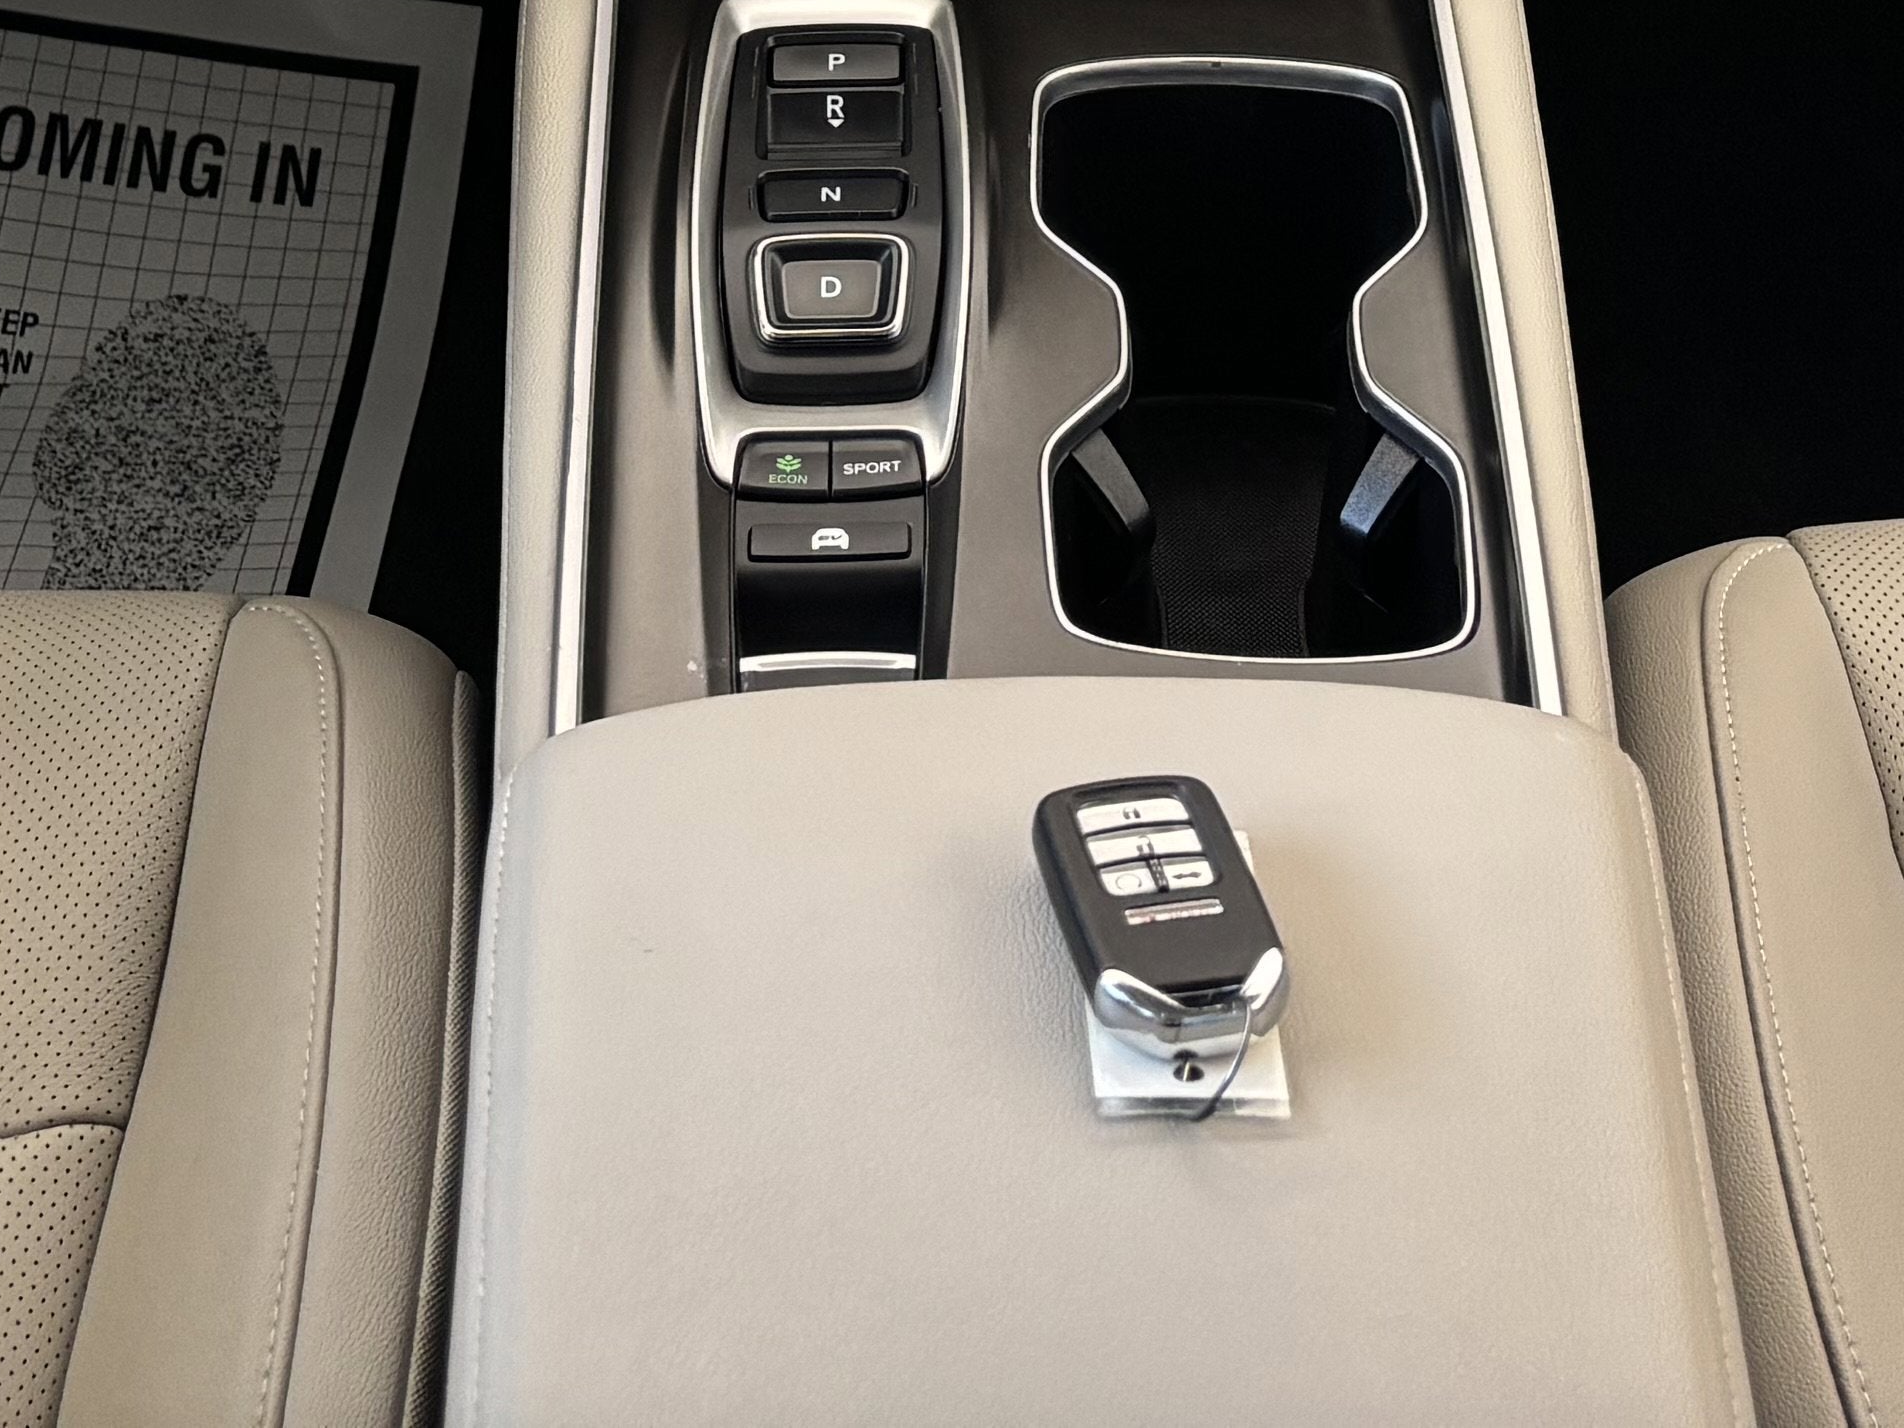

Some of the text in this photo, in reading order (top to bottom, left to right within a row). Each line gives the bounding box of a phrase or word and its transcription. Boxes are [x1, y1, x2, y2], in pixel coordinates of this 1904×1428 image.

[828, 54, 845, 71] P
[826, 95, 844, 118] R
[249, 140, 324, 208] IN
[820, 186, 842, 203] N
[820, 275, 842, 298] D
[842, 459, 902, 476] SPORT
[768, 473, 808, 485] ECON
